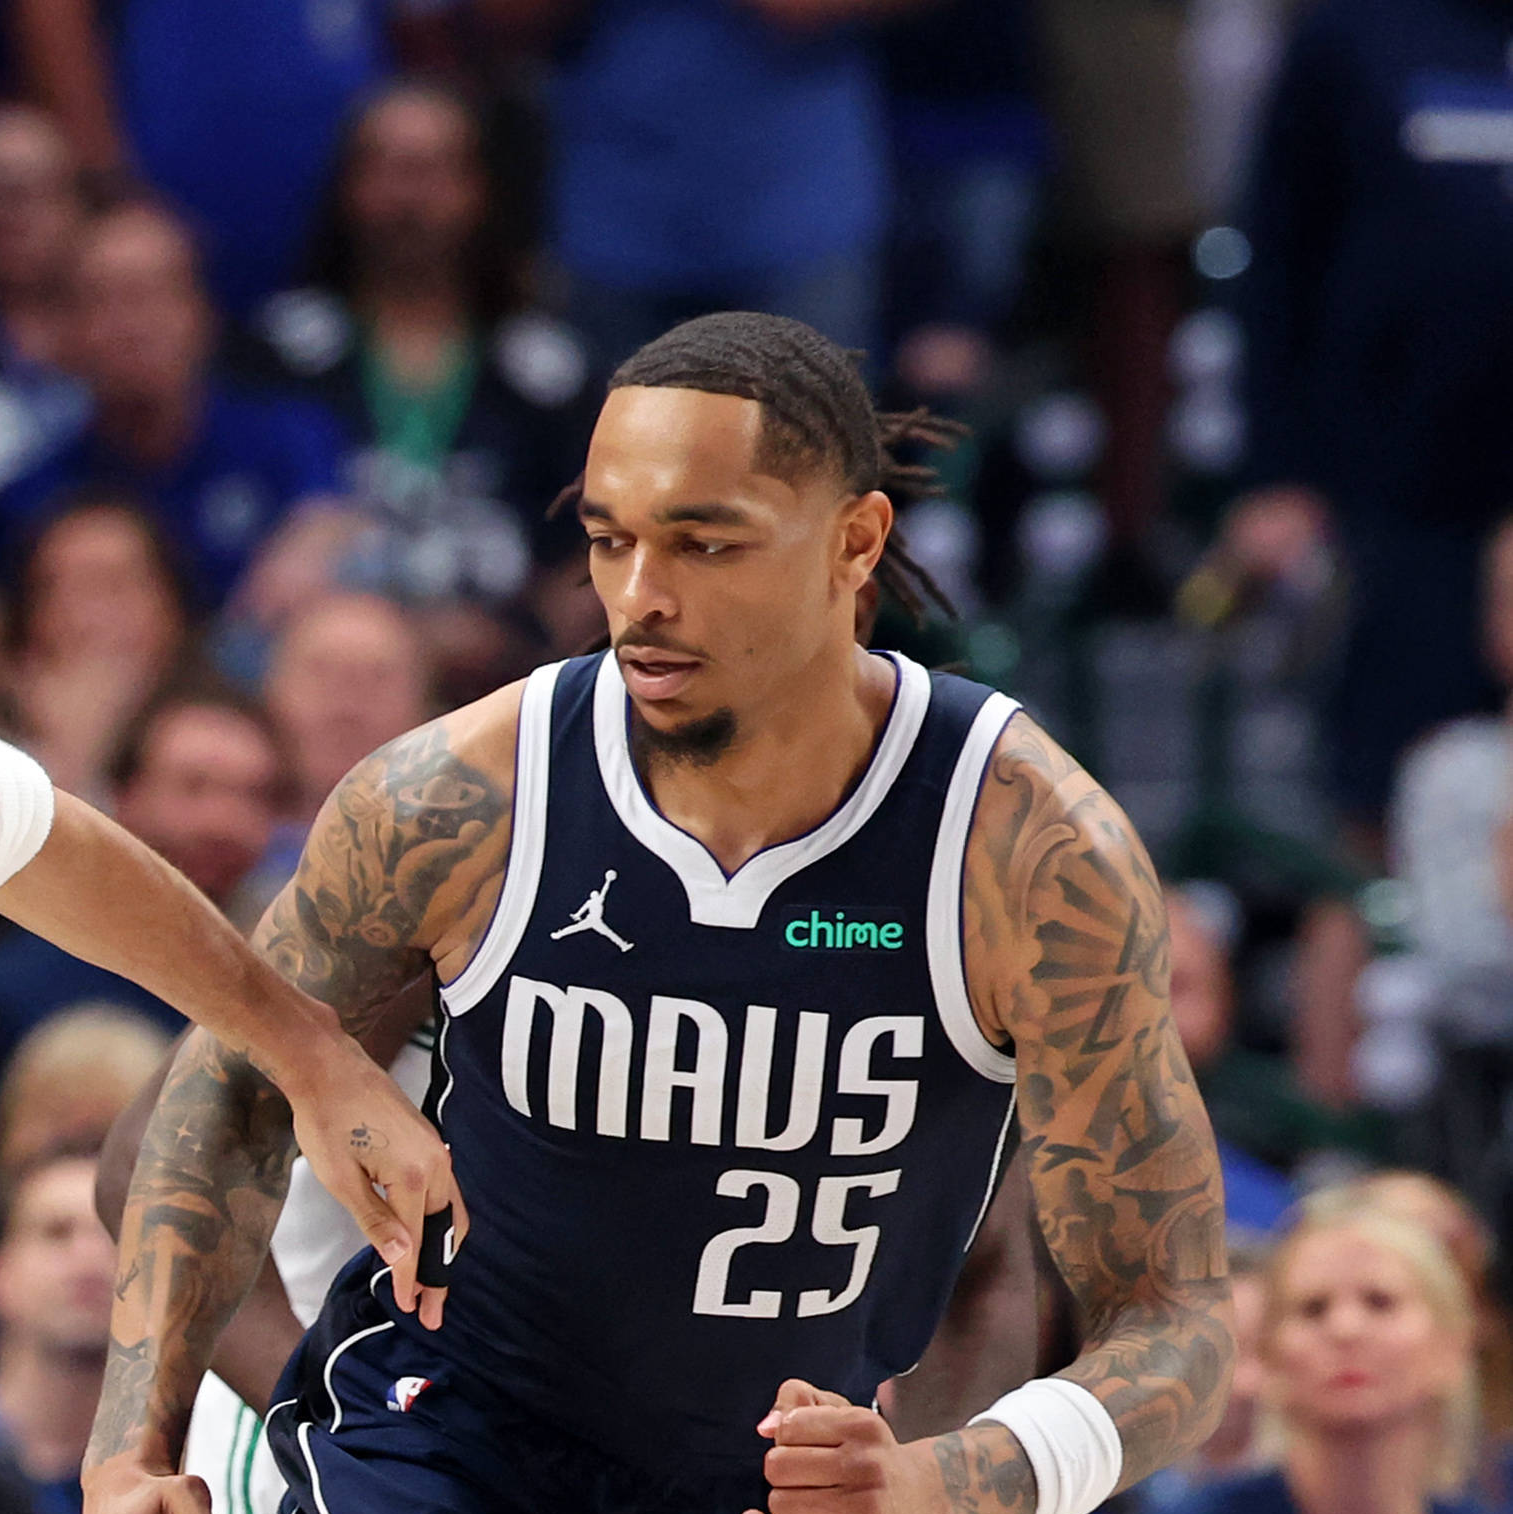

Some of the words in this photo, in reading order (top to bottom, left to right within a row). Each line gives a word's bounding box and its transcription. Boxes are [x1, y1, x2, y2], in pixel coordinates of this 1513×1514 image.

[784, 910, 904, 950] chime
[500, 974, 925, 1156] MAVS
[692, 1168, 903, 1319] 25
